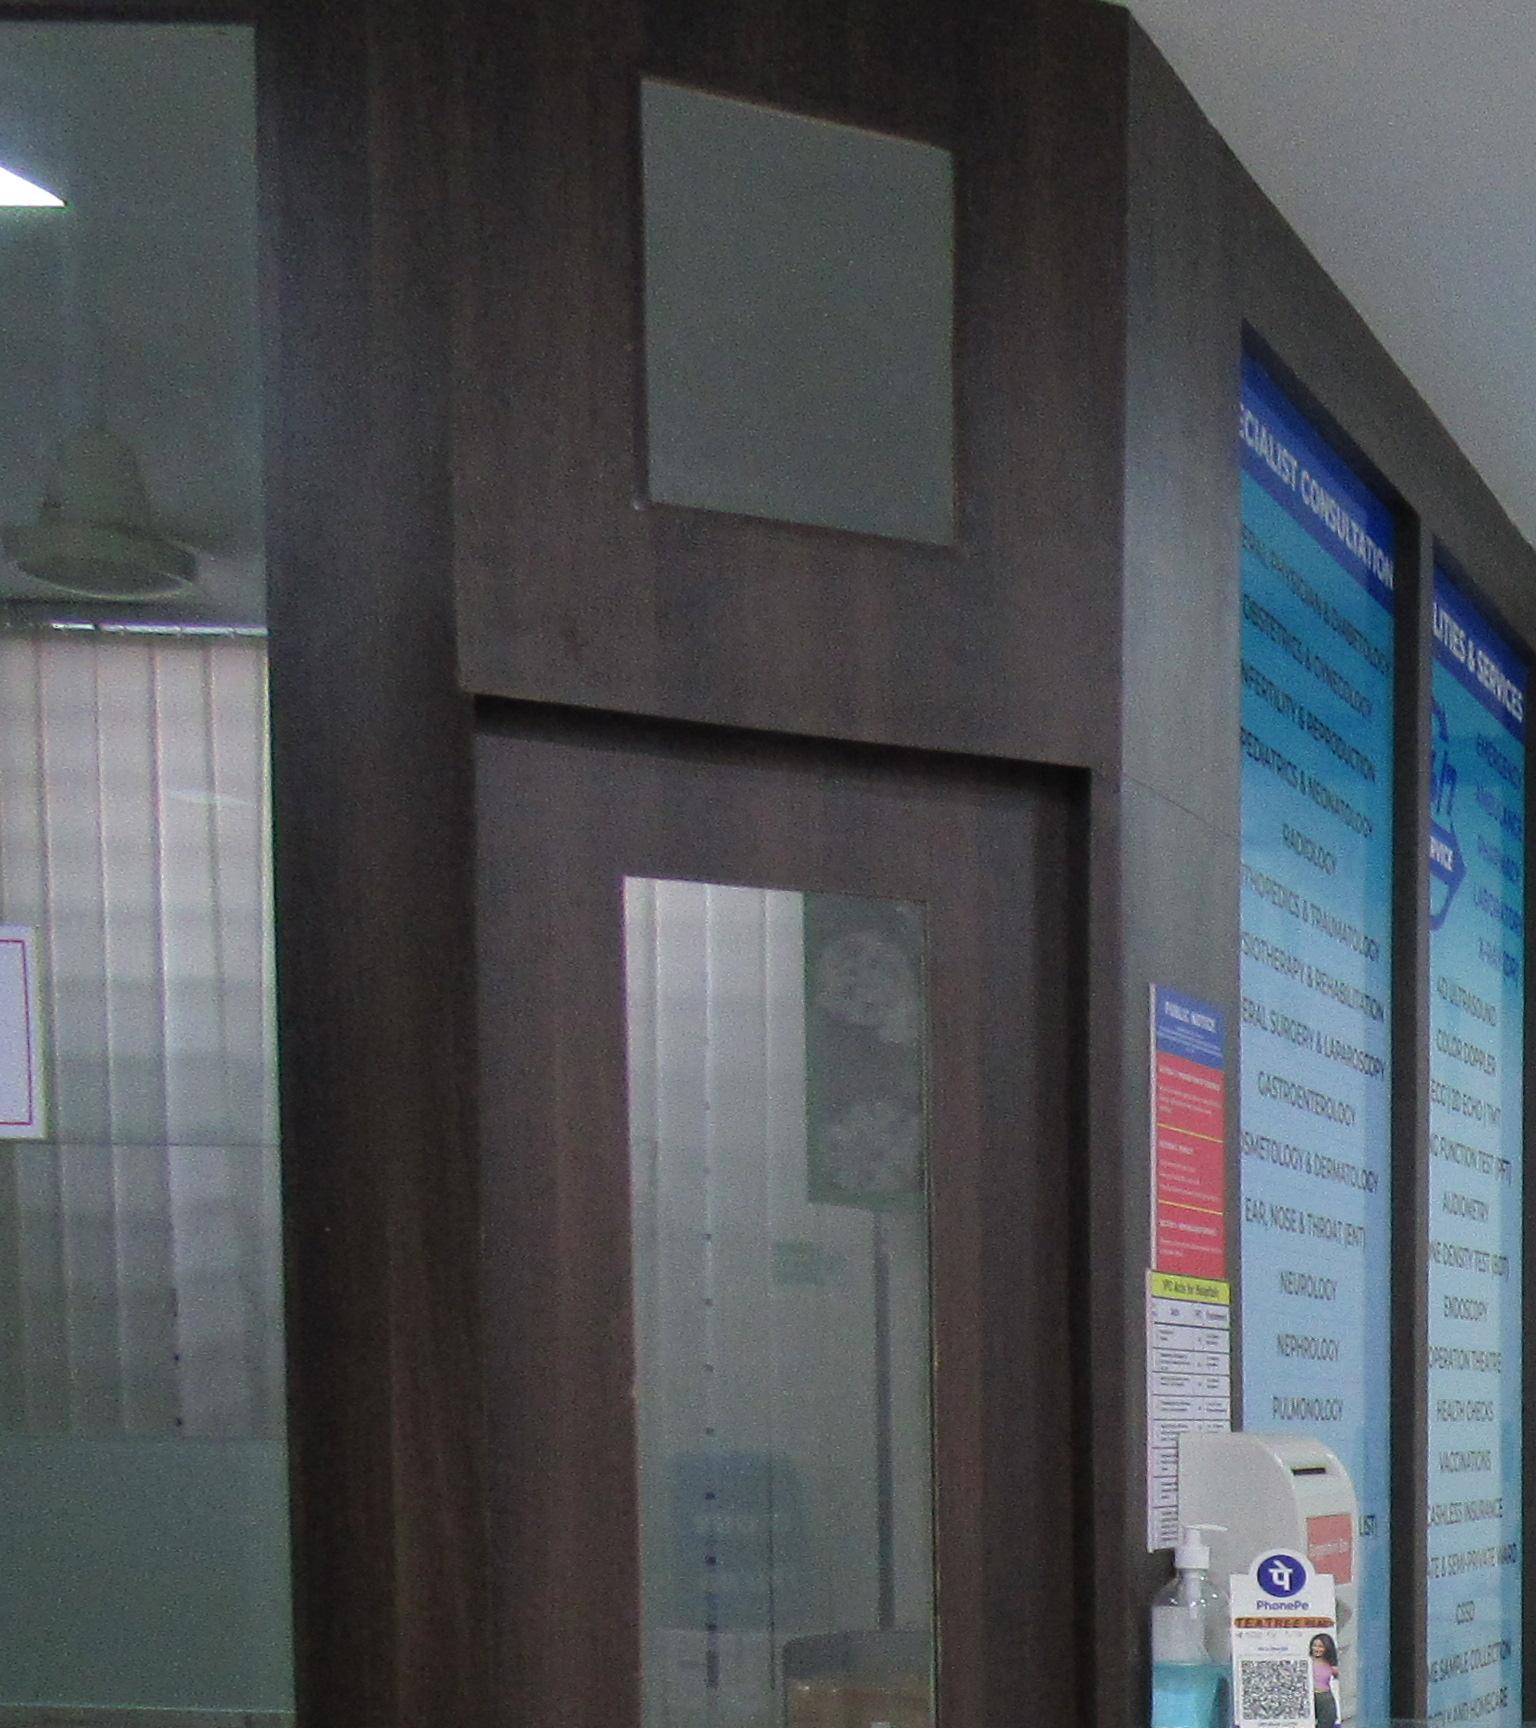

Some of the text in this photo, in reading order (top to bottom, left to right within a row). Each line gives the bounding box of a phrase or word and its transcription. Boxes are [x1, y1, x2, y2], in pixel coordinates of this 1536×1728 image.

[1301, 466, 1391, 592] CONSULTATION
[1477, 646, 1522, 724] SERVICES
[1269, 1203, 1295, 1233] NOSE
[1307, 1213, 1341, 1244] THROAT
[1280, 1268, 1337, 1302] NEUROLOGY
[1277, 1331, 1339, 1362] NEPHROLOGY
[1273, 1396, 1342, 1422] PULMONOLOGY
[1256, 1600, 1309, 1611] PhonePe
